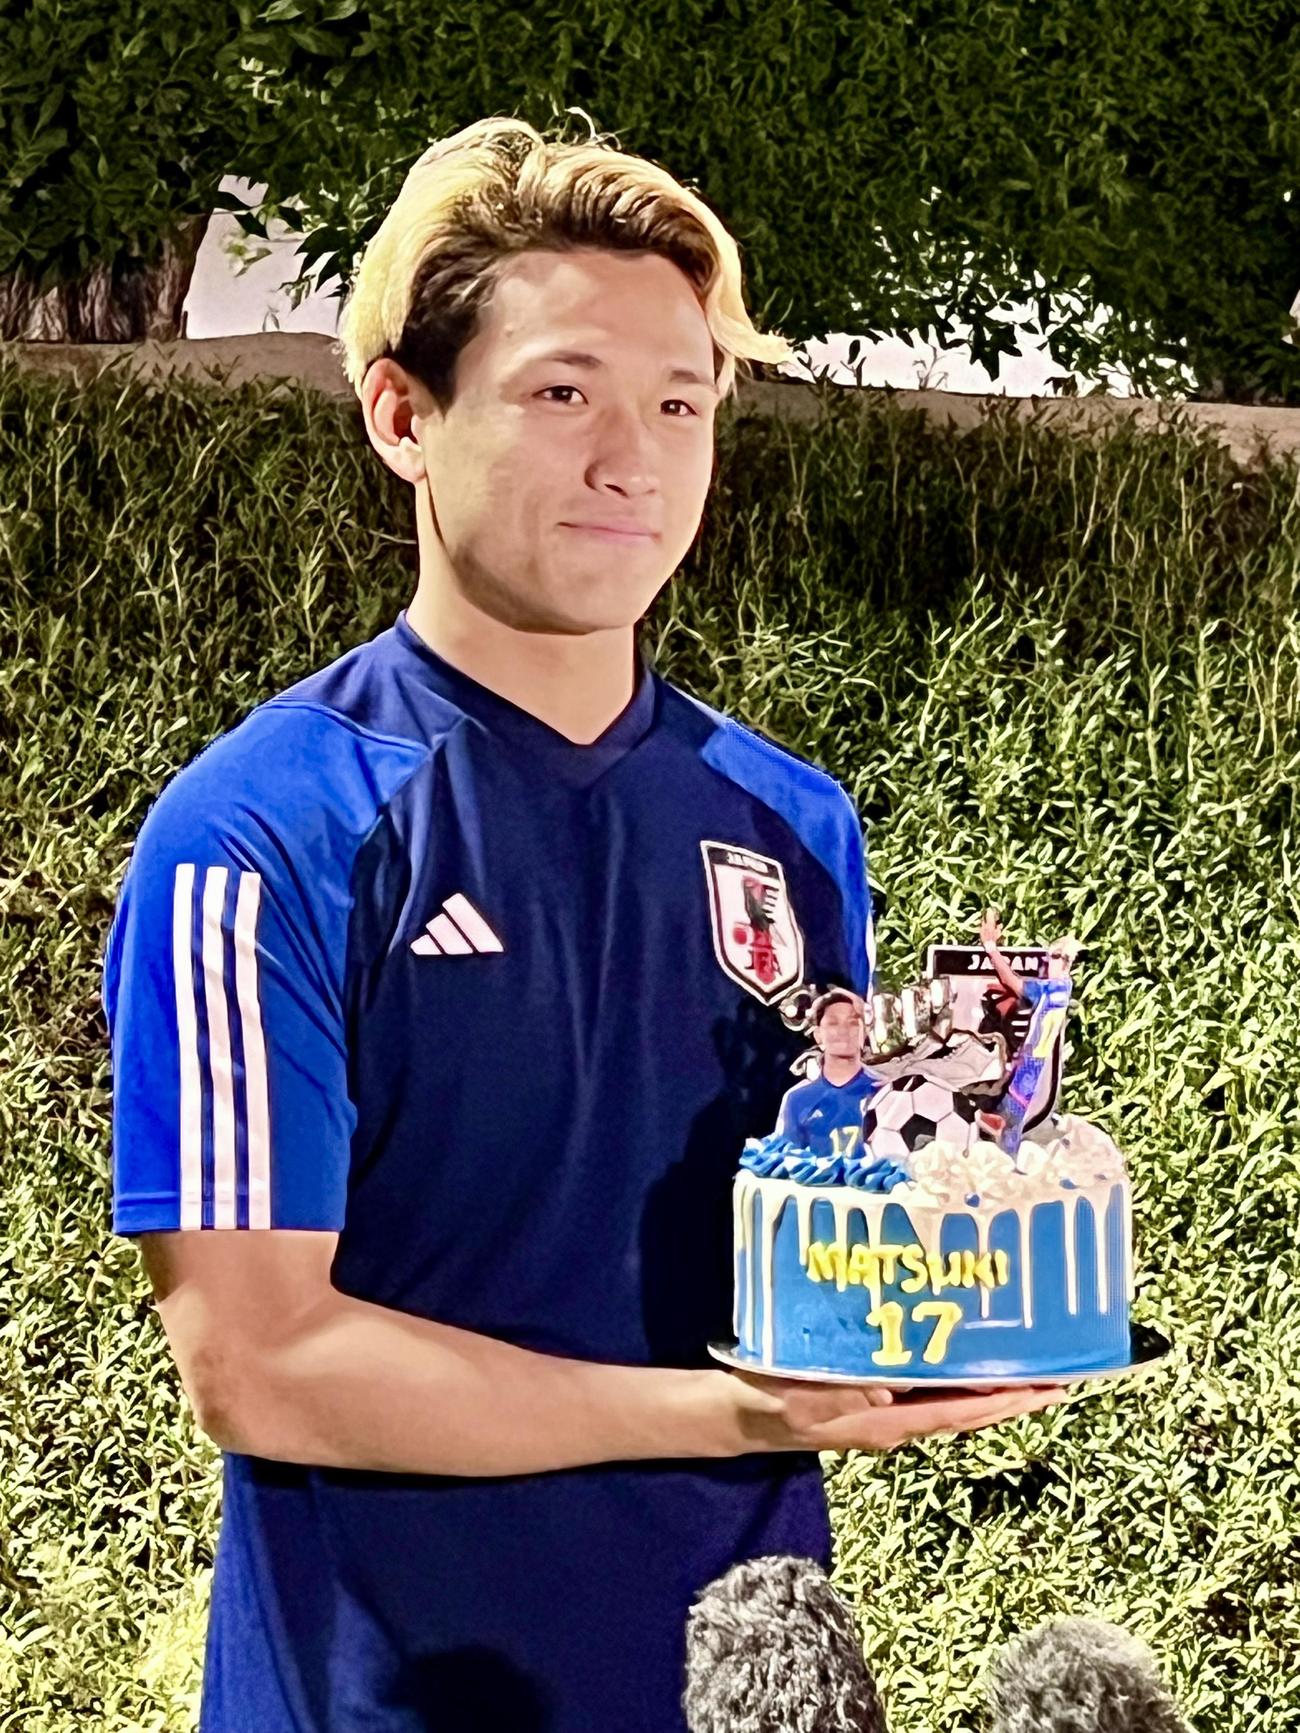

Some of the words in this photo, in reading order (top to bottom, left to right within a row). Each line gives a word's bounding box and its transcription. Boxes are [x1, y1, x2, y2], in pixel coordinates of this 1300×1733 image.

[829, 1126, 860, 1160] 17
[806, 1240, 1010, 1293] MATSUKI
[865, 1301, 963, 1366] 17
